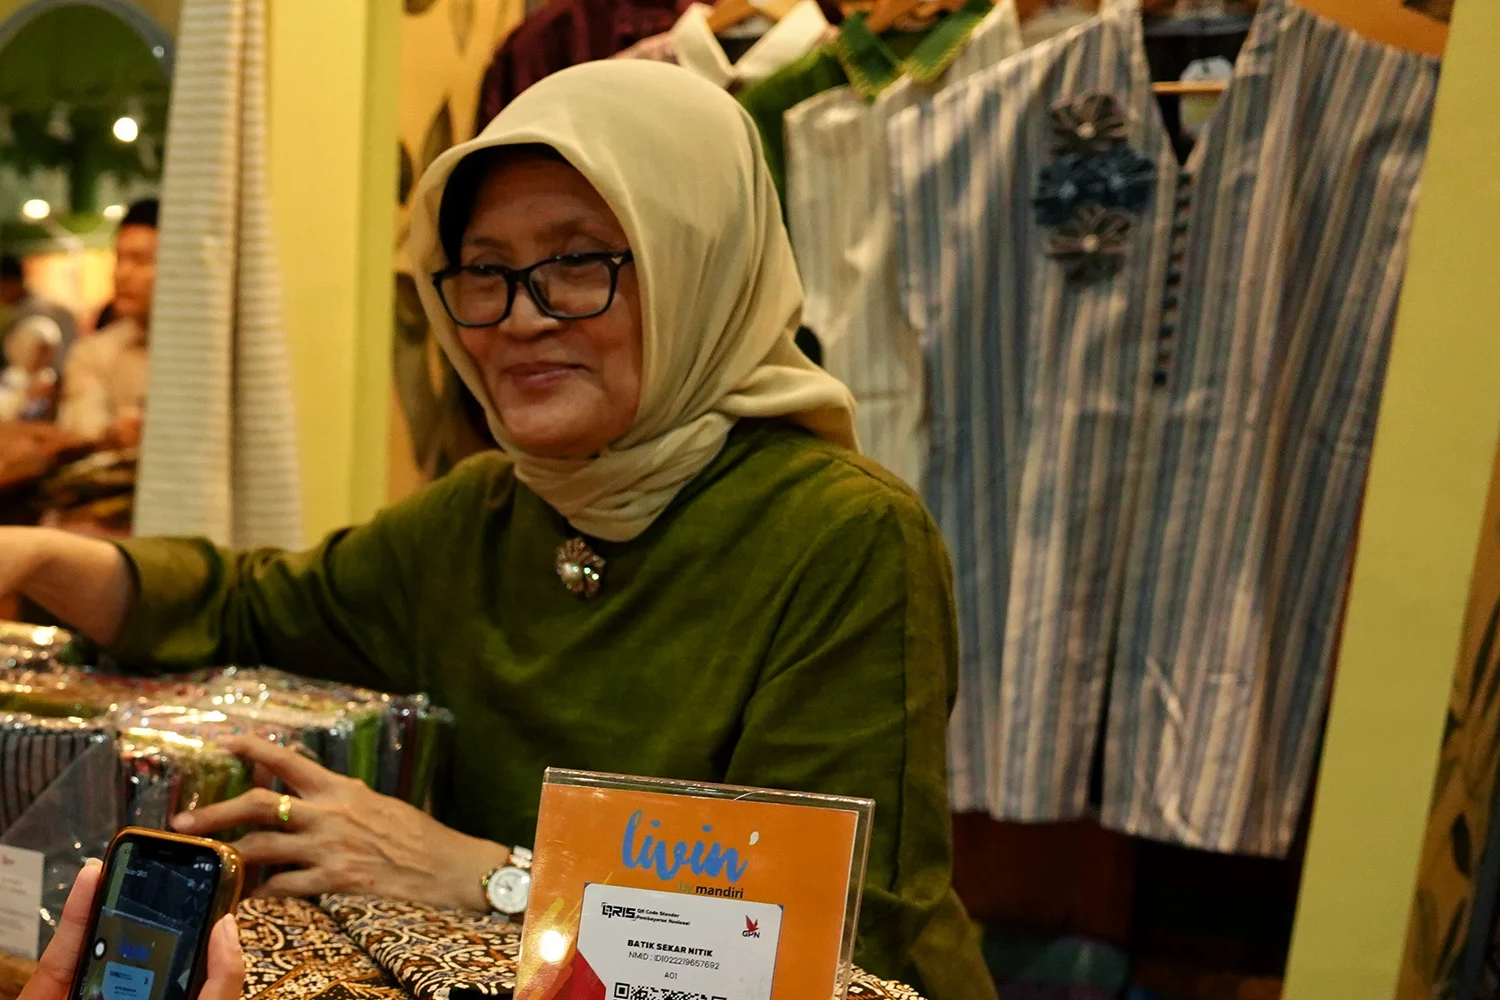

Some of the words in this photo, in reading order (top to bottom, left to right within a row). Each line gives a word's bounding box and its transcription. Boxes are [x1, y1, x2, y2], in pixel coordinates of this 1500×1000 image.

[678, 881, 693, 895] by
[695, 885, 744, 899] mandiri
[601, 902, 638, 921] QRIS
[742, 929, 761, 939] GPN
[627, 939, 655, 950] BATIK
[656, 943, 687, 954] SEKAR
[688, 947, 714, 957] NITIK
[628, 951, 649, 961] NMID
[663, 972, 678, 980] A01
